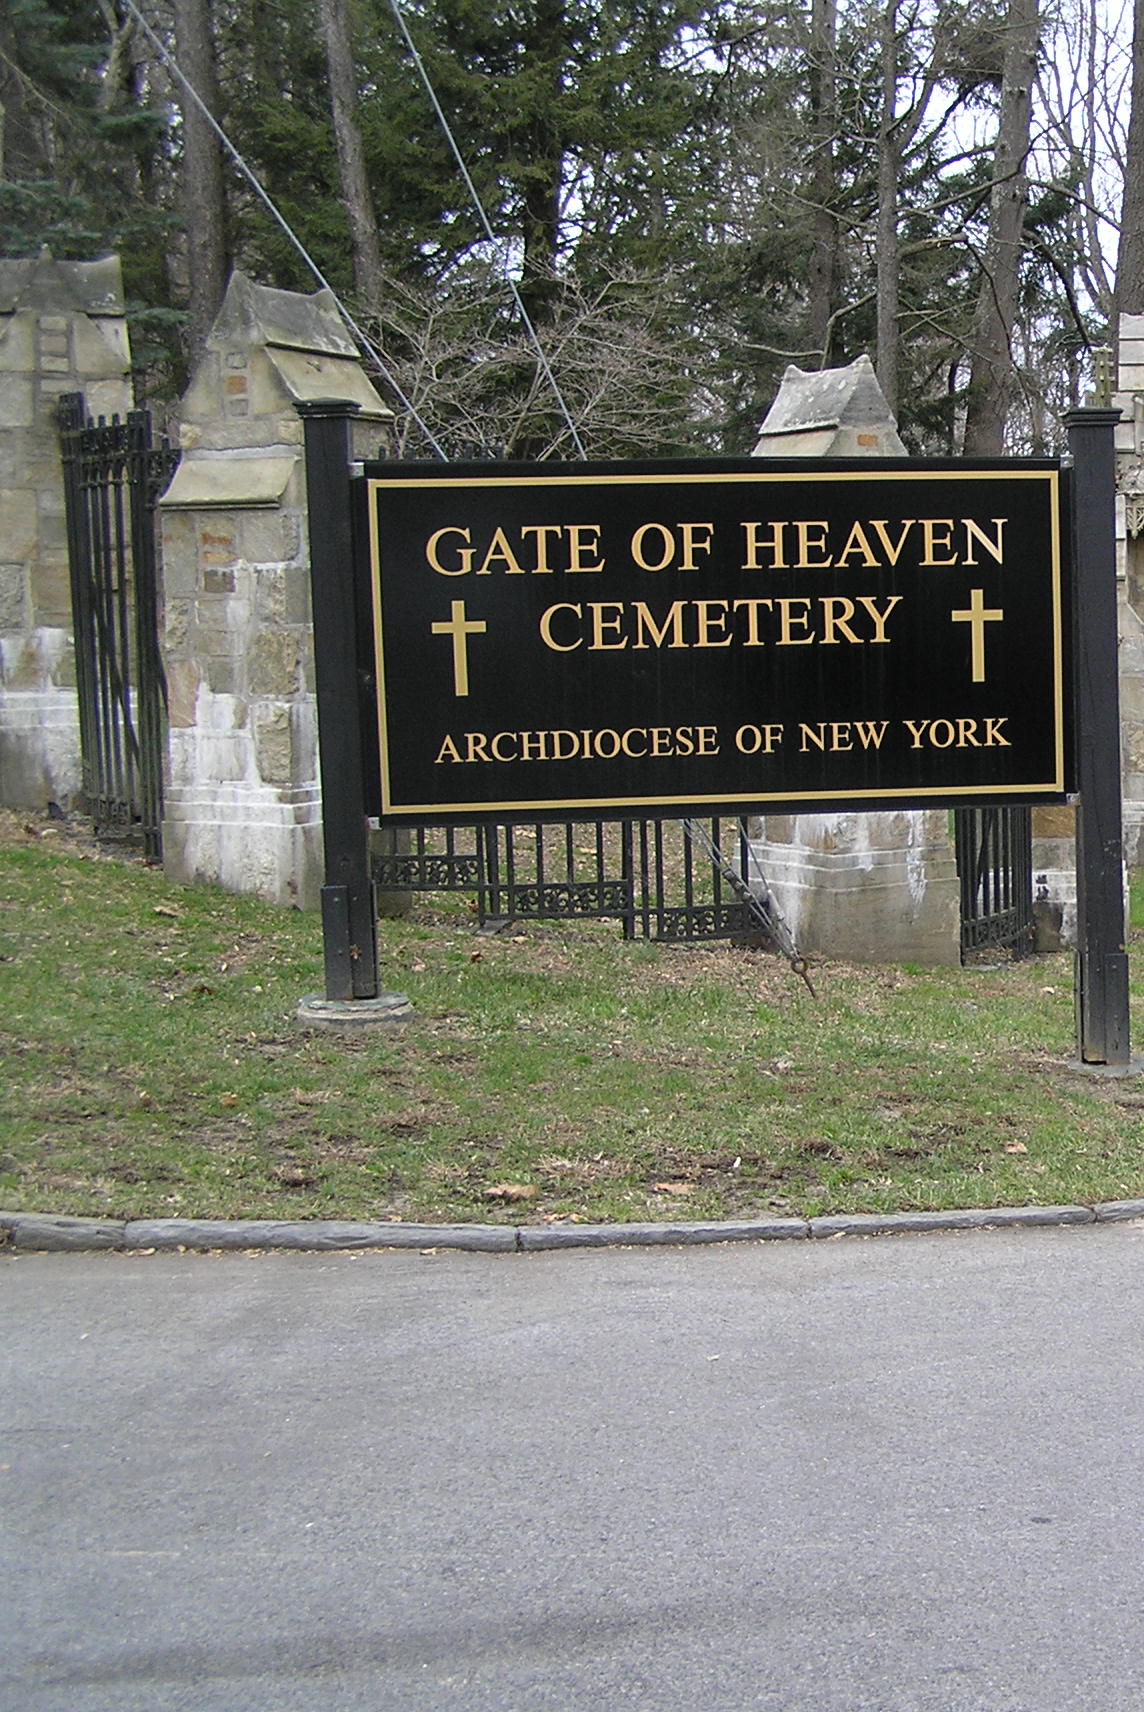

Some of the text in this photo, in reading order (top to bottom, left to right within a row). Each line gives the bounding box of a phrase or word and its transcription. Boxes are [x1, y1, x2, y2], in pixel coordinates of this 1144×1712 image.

[426, 519, 1008, 576] GATE OF HEAVEN
[540, 596, 903, 651] CEMETERY
[435, 718, 1011, 763] ARCHDIOCESE OF NEW YORK
